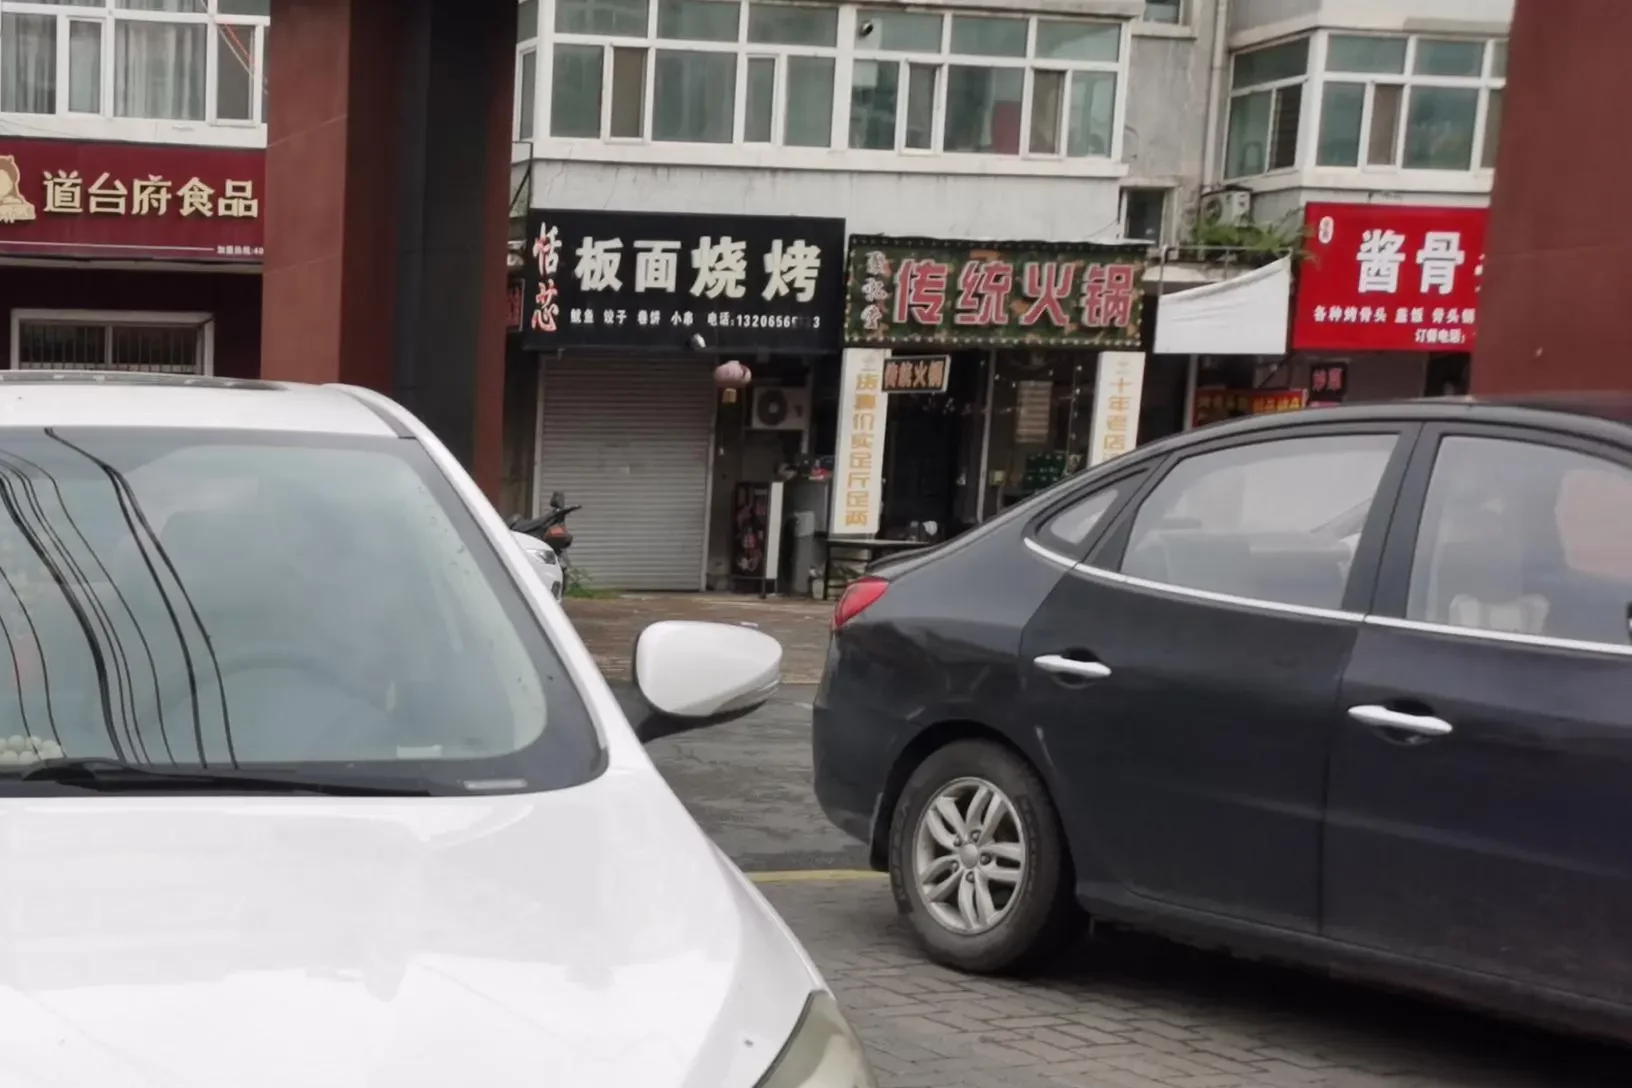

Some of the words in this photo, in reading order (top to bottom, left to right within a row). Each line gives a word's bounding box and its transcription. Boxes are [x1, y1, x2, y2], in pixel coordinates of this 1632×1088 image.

[42, 168, 259, 219] 道台府食品
[573, 236, 822, 302] 板面烧烤
[893, 259, 1135, 327] 传统火锅
[1355, 228, 1485, 295] 酱骨
